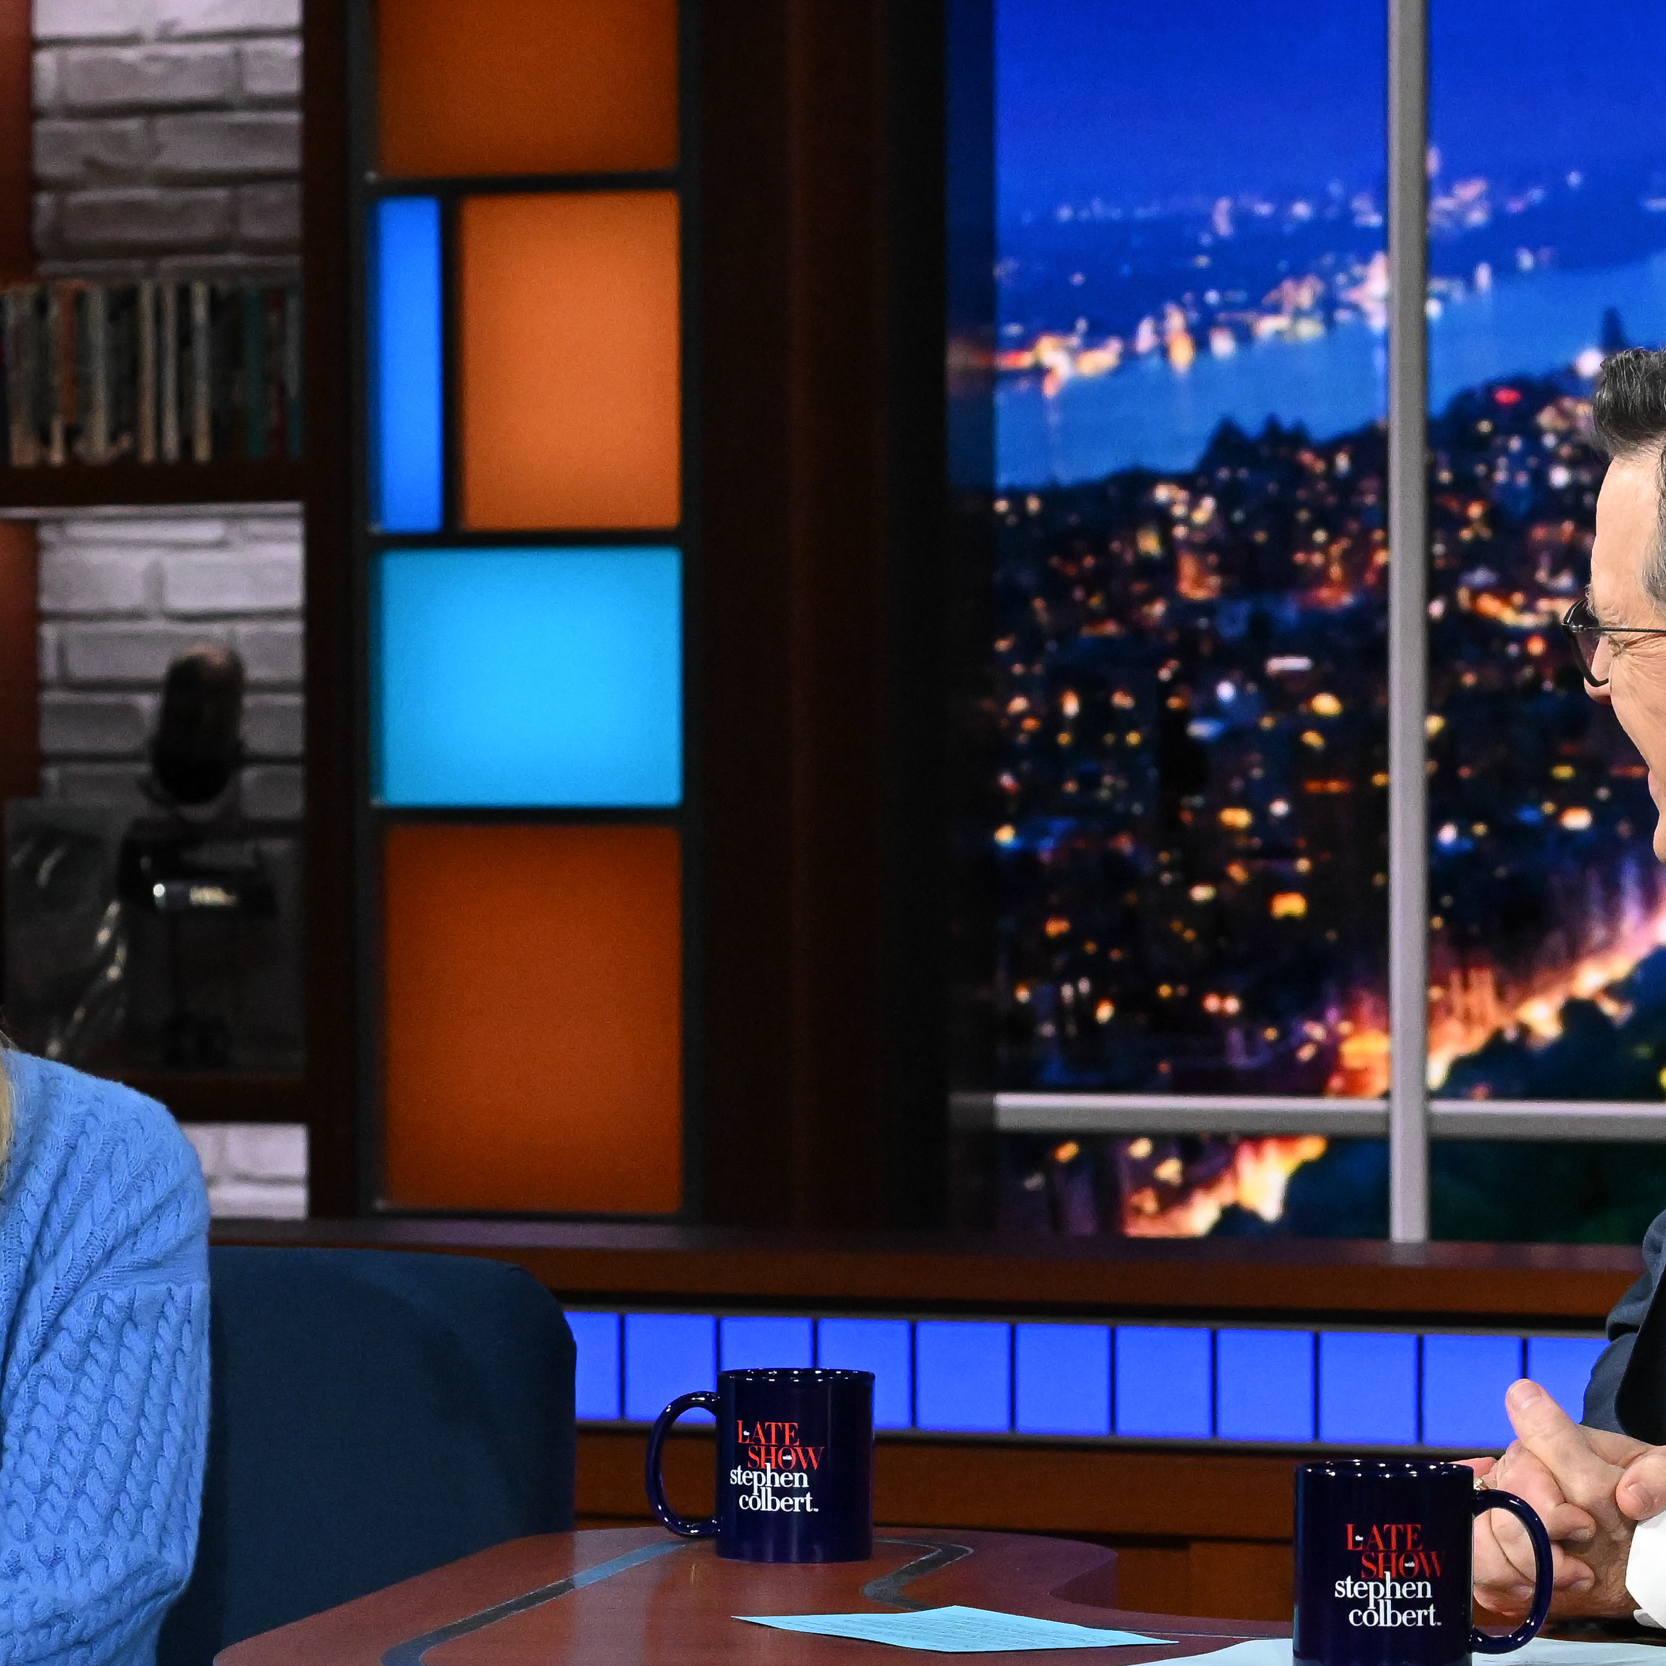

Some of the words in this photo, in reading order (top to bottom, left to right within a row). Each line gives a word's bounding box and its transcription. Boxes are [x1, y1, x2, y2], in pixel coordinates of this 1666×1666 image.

[736, 1420, 800, 1446] LATE
[747, 1445, 825, 1470] SHOW
[729, 1462, 810, 1496] stephen
[1345, 1523, 1423, 1551] LATE
[1361, 1551, 1447, 1579] SHOW
[1334, 1571, 1433, 1609] stephen
